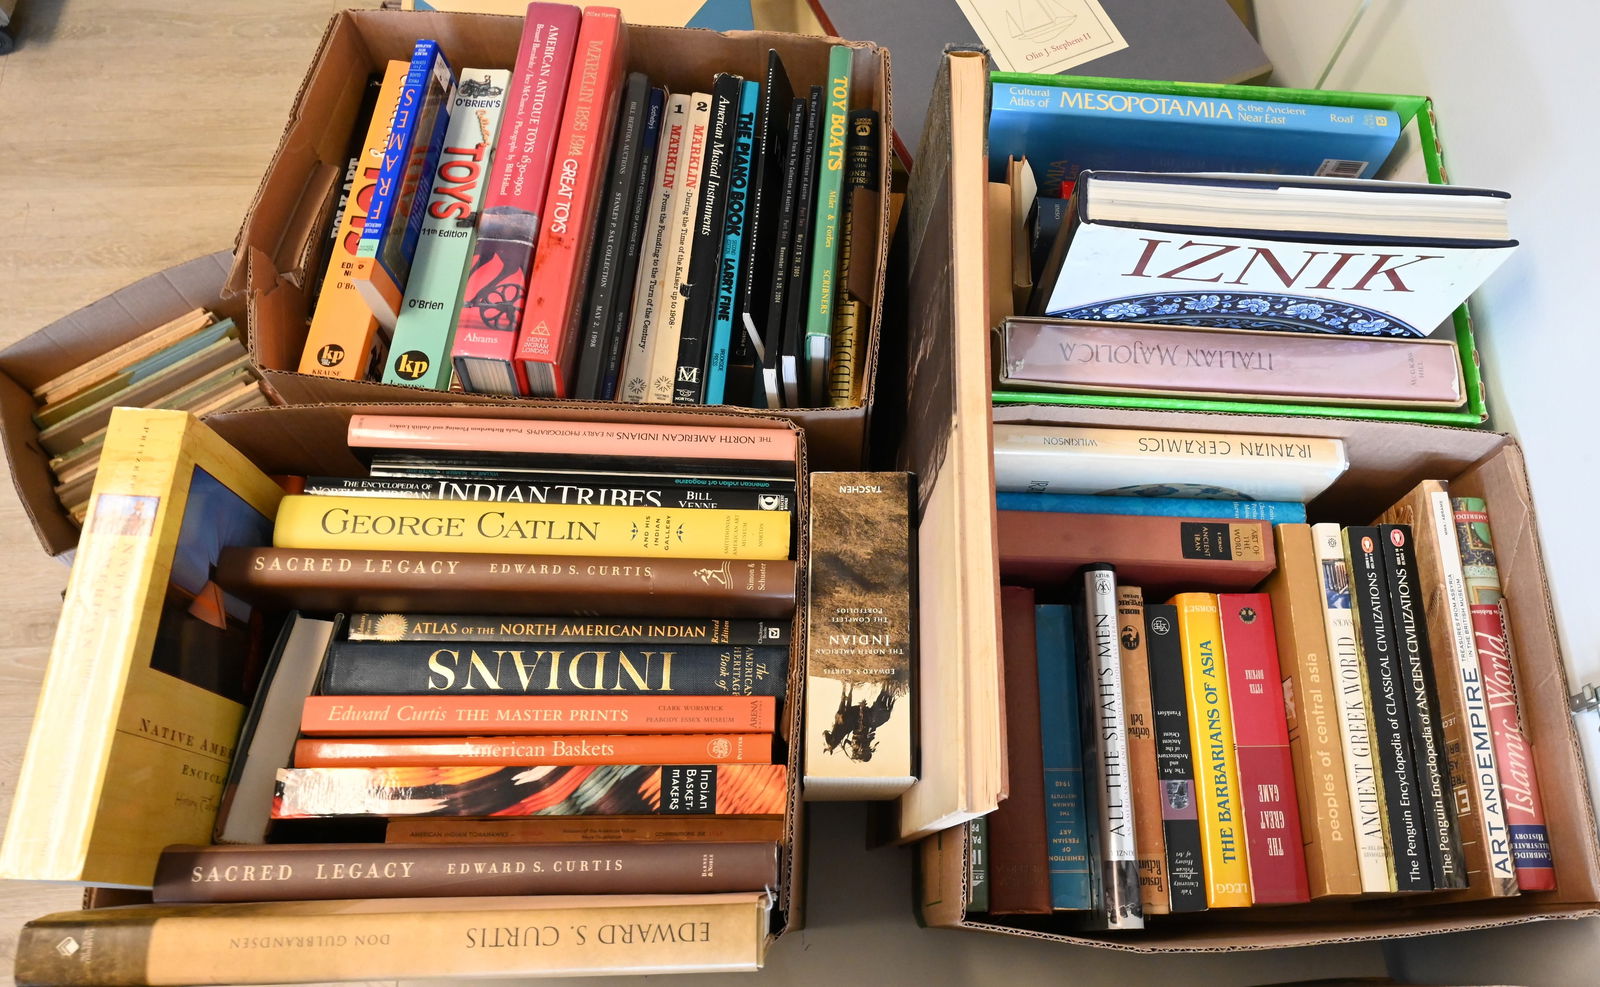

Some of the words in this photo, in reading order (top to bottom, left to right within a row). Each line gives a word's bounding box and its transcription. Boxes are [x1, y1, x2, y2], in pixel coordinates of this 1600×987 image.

[1025, 50, 1043, 62] Olin
[1051, 37, 1083, 54] Stephens
[832, 76, 848, 111] TOY
[1009, 87, 1050, 97] Cultural
[1009, 96, 1035, 107] Atlas
[1038, 99, 1050, 108] of
[1059, 91, 1234, 119] MESOPOTAMIA
[674, 104, 684, 114] 1
[696, 102, 708, 112] 2
[714, 95, 730, 142] American
[1238, 114, 1264, 124] Near
[1264, 114, 1287, 124] East
[1247, 104, 1265, 113] the
[1266, 106, 1307, 116] Ancient
[1330, 113, 1355, 124] Roaf
[738, 112, 754, 139] THE
[828, 113, 846, 171] BOATS
[709, 141, 725, 179] Musical
[731, 140, 750, 189] PIANO
[428, 144, 488, 220] TOYS
[558, 158, 578, 200] GREAT
[662, 193, 670, 210] From
[701, 180, 720, 237] Instruments
[726, 190, 745, 236] BOOK
[551, 201, 573, 234] TOYS
[659, 211, 667, 224] the
[652, 224, 666, 259] Founding
[652, 259, 659, 268] to
[721, 258, 736, 293] LARRY
[1121, 237, 1445, 293] IZNIK
[647, 279, 657, 301] Turn
[409, 298, 444, 311] O'Brien
[644, 307, 653, 319] the
[646, 300, 654, 308] of
[718, 295, 732, 322] FINE
[464, 332, 498, 344] Abrams
[638, 320, 651, 350] Century
[1059, 342, 1179, 366] MAJOLICA
[1186, 350, 1273, 371] ITALIAN
[616, 432, 659, 441] INDIANS
[662, 433, 716, 443] AMERICAN
[720, 435, 756, 444] NORTH
[1043, 436, 1098, 447] WILKINSON
[1138, 437, 1231, 456] CERAMICS
[1241, 442, 1311, 458] IRANIAN
[343, 480, 359, 488] THE
[361, 480, 419, 489] ENCYCLOPEDIA
[438, 481, 550, 503] INDIAN
[554, 485, 662, 508] TRIBES
[686, 490, 713, 501] BILL
[839, 485, 882, 494] TASCHEN
[321, 507, 466, 538] GEORGE
[477, 511, 600, 541] CATLIN
[664, 515, 672, 551] GALLERY
[1202, 526, 1211, 557] ANCIENT
[1234, 529, 1242, 557] WORLD
[254, 556, 352, 572] SACRED
[364, 559, 460, 575] LEGACY
[489, 563, 562, 576] EDWARD
[569, 565, 579, 575] S.
[587, 565, 651, 577] CURTIS
[758, 562, 766, 591] Schuster
[1448, 574, 1456, 601] ASSYRIA
[1366, 572, 1388, 652] CIVILIZATIONS
[1395, 568, 1419, 652] CIVILIZATIONS
[1451, 601, 1459, 621] FROM
[412, 622, 458, 635] ATLAS
[462, 626, 475, 635] OF
[476, 626, 495, 635] THE
[500, 623, 556, 636] NORTH
[560, 624, 643, 637] AMERICAN
[648, 625, 706, 638] INDIAN
[711, 619, 719, 644] Revised
[721, 620, 729, 644] Edition
[829, 634, 891, 646] INDIAN
[1094, 614, 1111, 657] MEN
[1456, 621, 1466, 663] TREASURES
[428, 649, 677, 692] INDIANS
[720, 652, 731, 676] Book
[743, 646, 754, 697] AMERICAN
[755, 662, 769, 681] The
[1199, 640, 1216, 678] ASIA
[1306, 652, 1320, 683] asia
[1338, 637, 1361, 695] WORLD
[1479, 633, 1516, 711] World
[714, 678, 729, 692] of
[1204, 682, 1218, 705] OF
[1379, 655, 1398, 716] CLASSICAL
[1407, 655, 1427, 711] ANCIENT
[328, 705, 391, 721] Edward
[397, 705, 447, 721] Curtis
[455, 709, 489, 721] THE
[495, 709, 562, 722] MASTER
[569, 710, 629, 722] PRINTS
[1098, 667, 1118, 741] SHAH'S
[1311, 690, 1328, 743] central
[1347, 701, 1371, 759] GREEK
[1387, 717, 1399, 729] of
[1417, 712, 1431, 724] of
[1463, 668, 1492, 770] EMPIRE
[458, 741, 545, 758] American
[552, 740, 614, 758] Baskets
[1317, 749, 1332, 767] of
[1421, 724, 1442, 798] Encyclopedia
[1104, 751, 1121, 793] THE
[1207, 708, 1232, 822] BARBARIANS
[1391, 732, 1410, 806] Encyclopedia
[1500, 718, 1535, 818] Islamic
[1258, 784, 1280, 802] GAME
[1353, 763, 1382, 839] ANCIENT
[1479, 773, 1499, 814] AND
[1108, 799, 1126, 837] ALL
[1260, 811, 1285, 829] GREAT
[1323, 773, 1343, 841] peoples
[1400, 810, 1417, 857] Penguin
[1433, 803, 1450, 852] Penguin
[1220, 827, 1236, 864] THE
[1267, 837, 1284, 856] THE
[1486, 822, 1513, 874] ART
[191, 863, 293, 883] SACRED
[316, 862, 415, 880] LEGACY
[447, 861, 526, 875] EDWARD
[533, 861, 545, 873] S.
[553, 859, 623, 872] CURTIS
[1405, 860, 1421, 882] The
[1440, 855, 1454, 876] The
[230, 935, 347, 949] GULBRANDSEN
[355, 933, 390, 946] DON
[467, 926, 560, 949] CURTIS
[571, 925, 588, 946] S.
[598, 922, 710, 946] EDWARD
